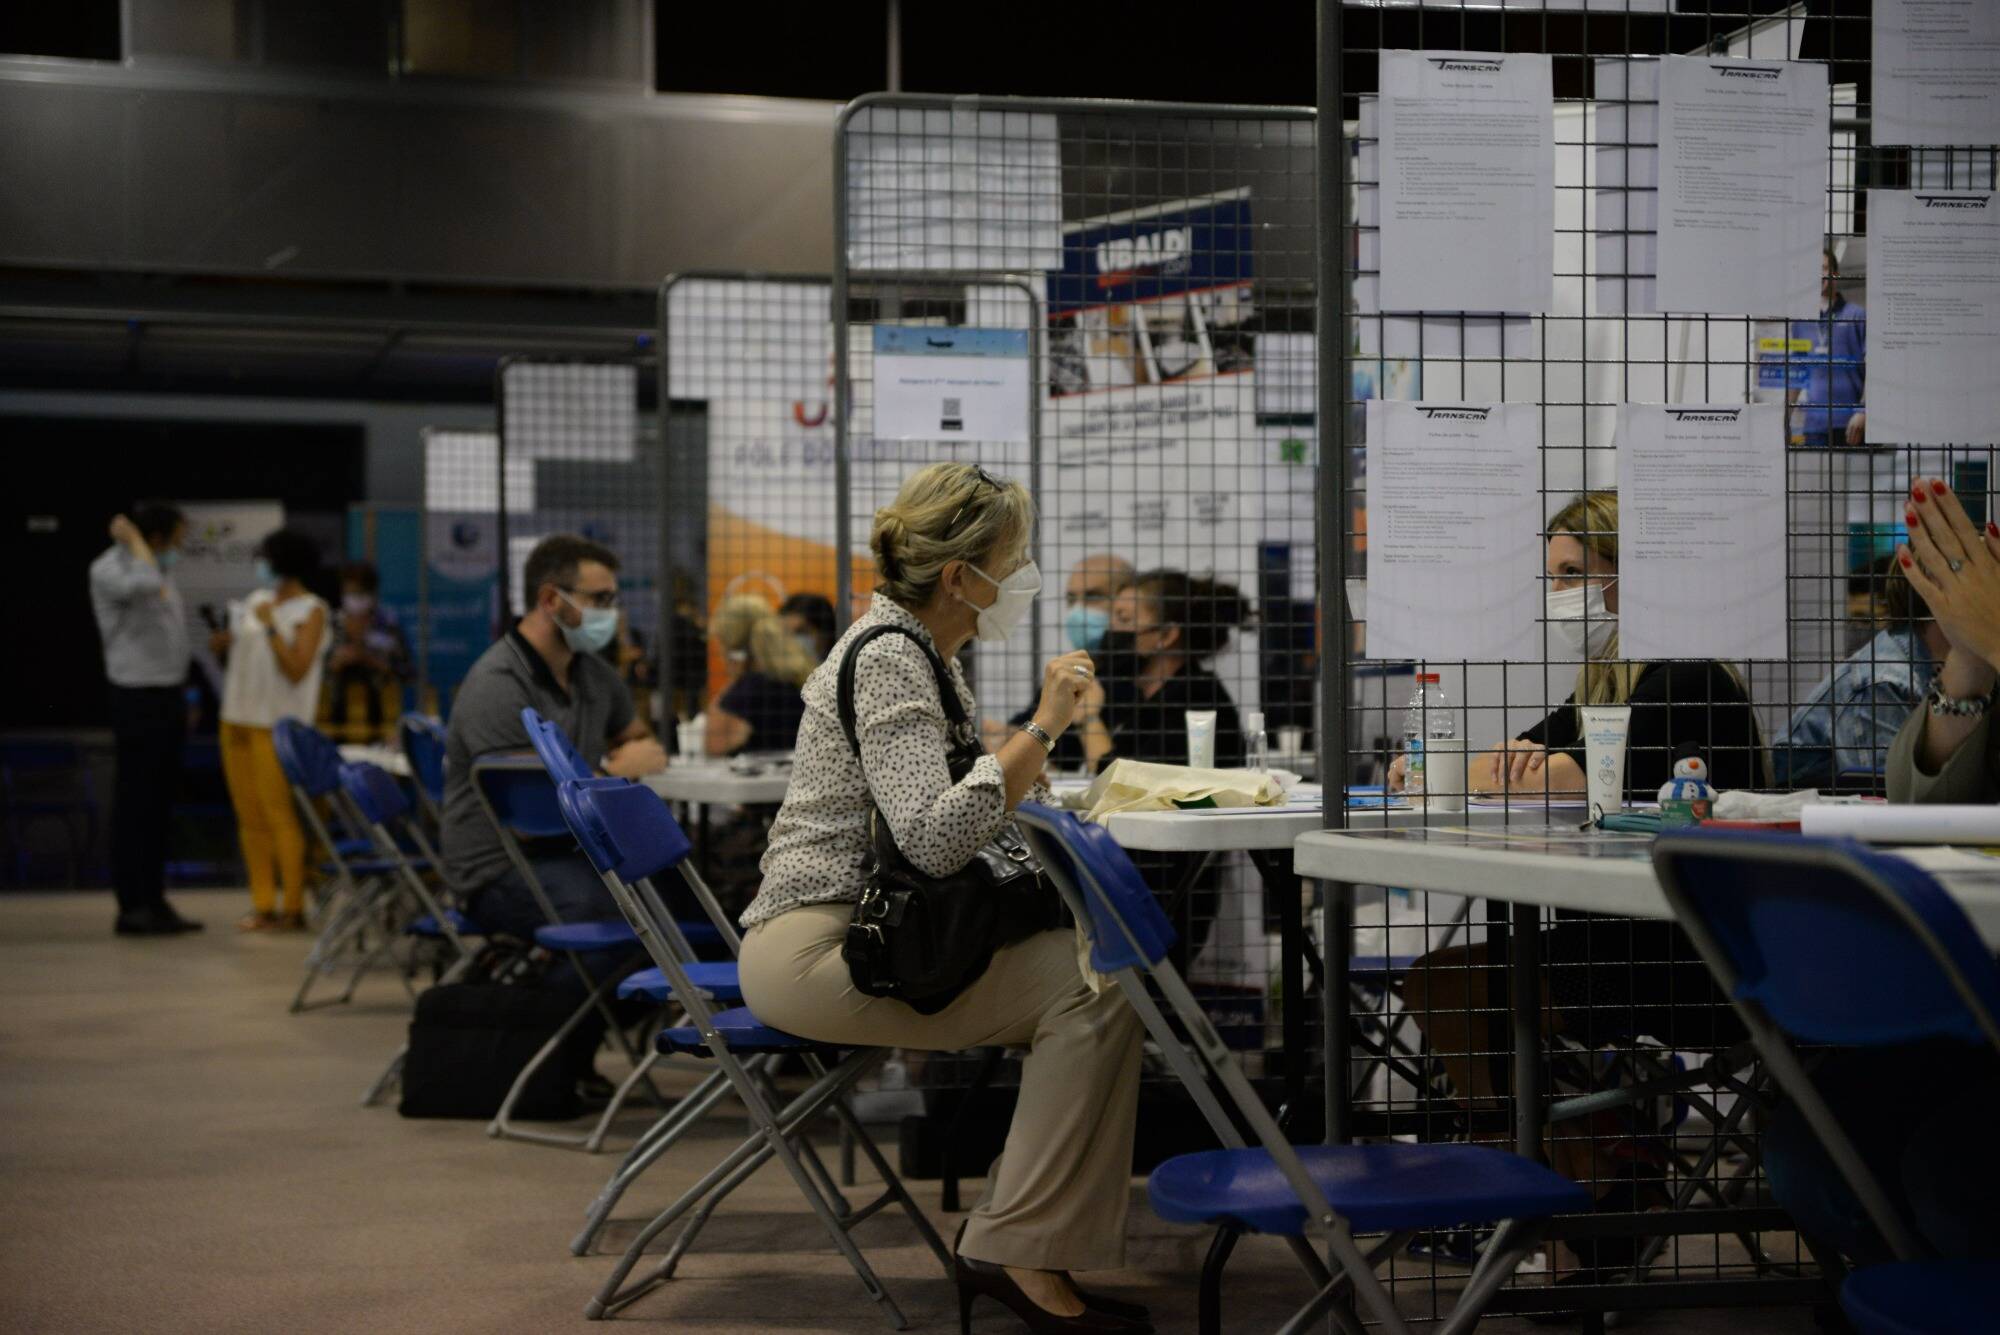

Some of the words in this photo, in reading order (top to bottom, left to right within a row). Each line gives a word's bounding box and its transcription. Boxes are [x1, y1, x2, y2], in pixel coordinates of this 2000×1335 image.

[1427, 58, 1504, 72] TRANSCAN
[1709, 65, 1783, 80] TRANSCAN
[1915, 195, 1991, 209] TRANSCAN
[1096, 226, 1193, 274] UBALDI
[1415, 406, 1491, 421] TRANSCAN
[1664, 408, 1741, 422] TRANSCAN
